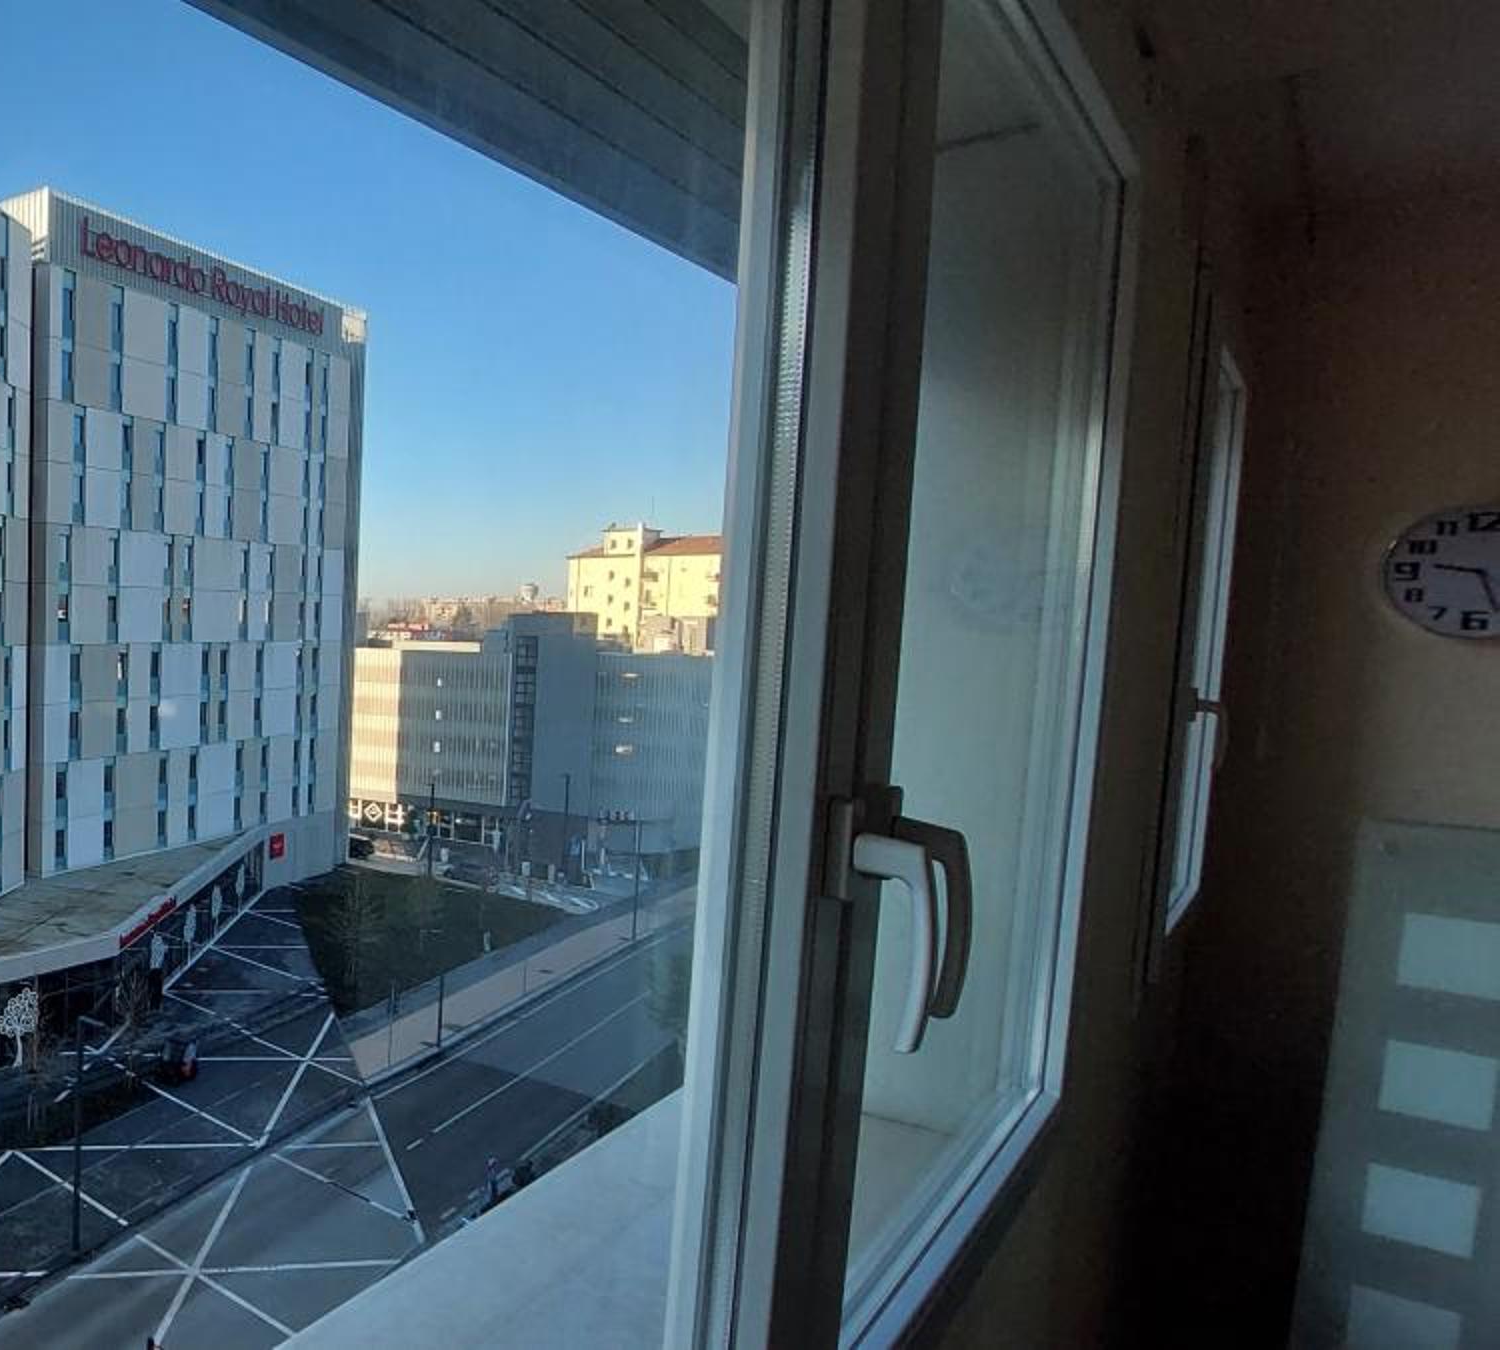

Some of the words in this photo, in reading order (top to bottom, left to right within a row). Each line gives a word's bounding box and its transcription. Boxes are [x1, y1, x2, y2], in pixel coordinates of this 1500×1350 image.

[81, 215, 205, 294] Leonardo
[212, 264, 271, 318] Royal
[276, 289, 324, 336] Hotel
[1435, 519, 1459, 537] 11
[1409, 538, 1437, 555] 10
[1394, 560, 1421, 582] 9
[1403, 587, 1424, 602] 8
[1428, 605, 1447, 621] 7
[1460, 609, 1490, 631] 6
